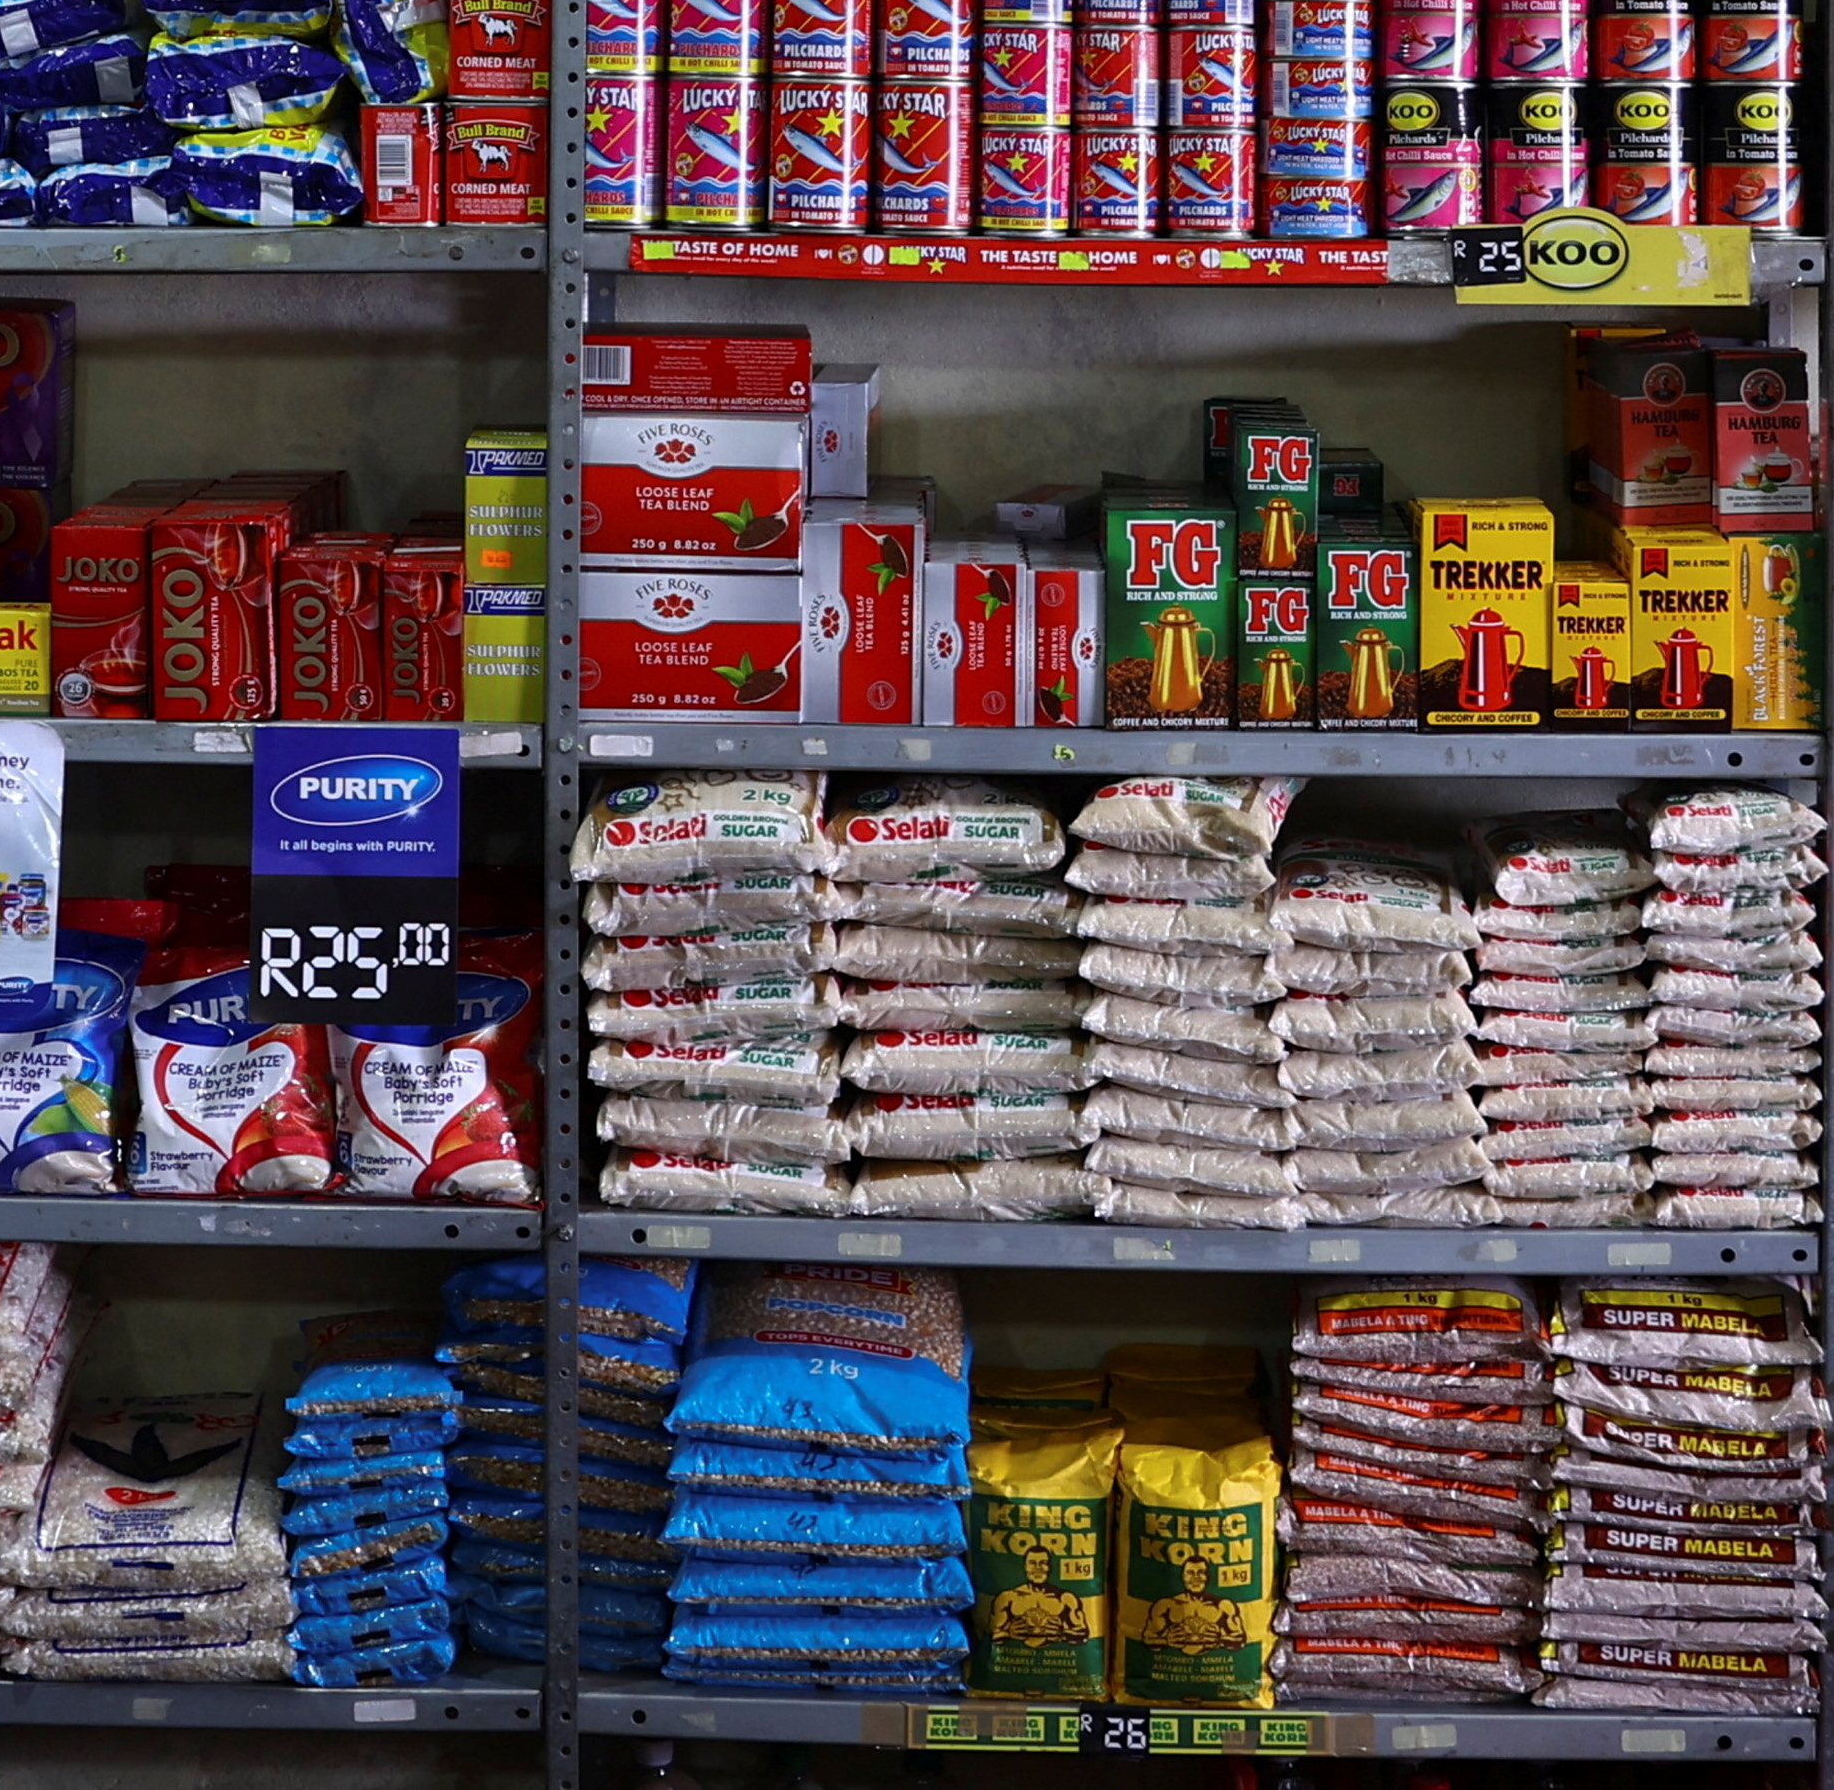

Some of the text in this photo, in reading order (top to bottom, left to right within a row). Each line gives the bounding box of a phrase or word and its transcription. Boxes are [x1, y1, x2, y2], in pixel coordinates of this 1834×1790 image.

[451, 182, 531, 195] CORNED MEAT
[672, 242, 799, 258] TASTE OF HOME
[1479, 241, 1521, 272] 25
[1529, 240, 1621, 266] KOO
[585, 395, 807, 406] COOL ONCE OPENED, STORE AIRTIGHT CONTAINER.
[638, 424, 714, 446] FIVE ROSES
[1728, 416, 1803, 432] HAMBURG
[635, 487, 714, 499] LOOSE LEAF
[469, 504, 543, 520] SULPHUR
[639, 499, 710, 511] TEA BLEND
[469, 522, 543, 537] FLOWERS
[632, 538, 700, 550] 250 8.82
[1126, 518, 1220, 592] FG
[1430, 560, 1543, 591] TREKKER
[163, 568, 208, 714] JOKO
[20, 666, 40, 678] TEA
[299, 777, 421, 802] PURITY
[640, 814, 706, 843] Selati
[721, 823, 779, 839] SUGAR
[280, 838, 436, 855] It all begins with PURITY.
[150, 1149, 214, 1166] Strawberry
[783, 1262, 894, 1287] PRIDE
[770, 1297, 904, 1328] POPCORN
[1604, 1310, 1765, 1337] SUPER MABELA
[809, 1358, 859, 1381] 2 kg
[987, 1500, 1091, 1531] KING
[980, 1530, 1098, 1557] KORN
[1104, 1717, 1146, 1749] 26
